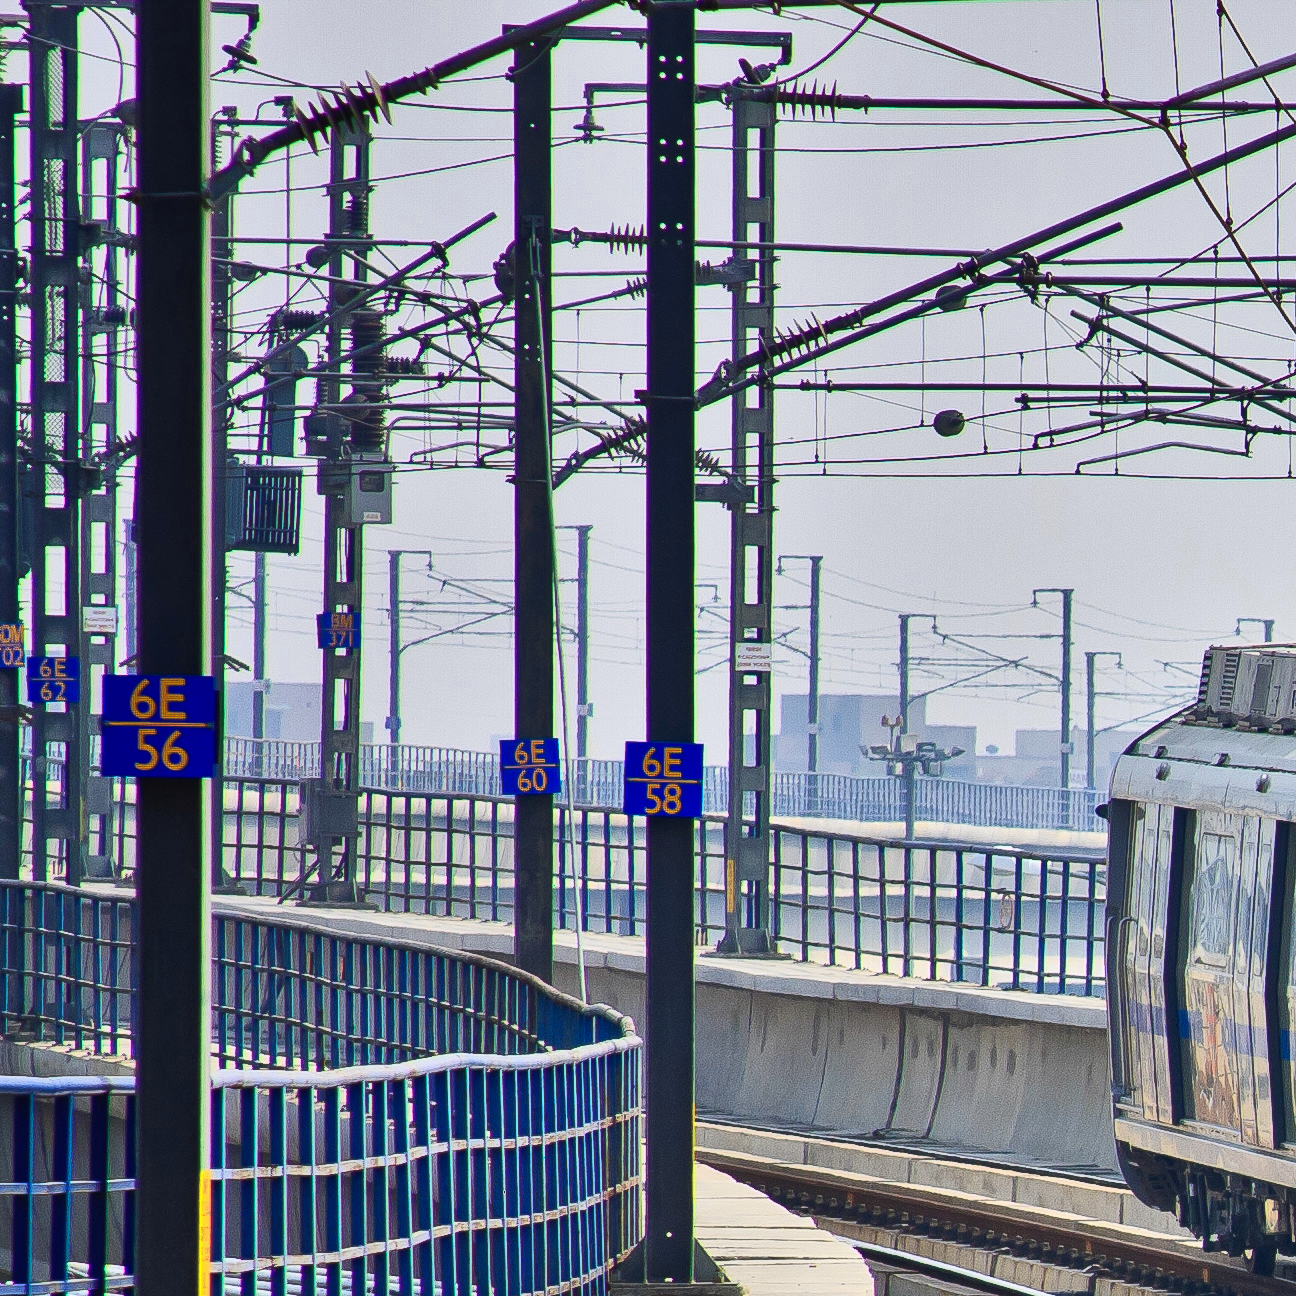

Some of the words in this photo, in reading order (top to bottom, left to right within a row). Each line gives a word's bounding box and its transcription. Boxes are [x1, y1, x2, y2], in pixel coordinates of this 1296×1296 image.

[0, 647, 24, 666] 02
[40, 658, 67, 677] 6E
[40, 682, 66, 701] 62
[130, 678, 187, 719] 6E
[134, 728, 189, 771] 56
[514, 740, 546, 764] 6E
[642, 747, 683, 778] 6E
[517, 767, 548, 792] 60
[644, 783, 682, 815] 58
